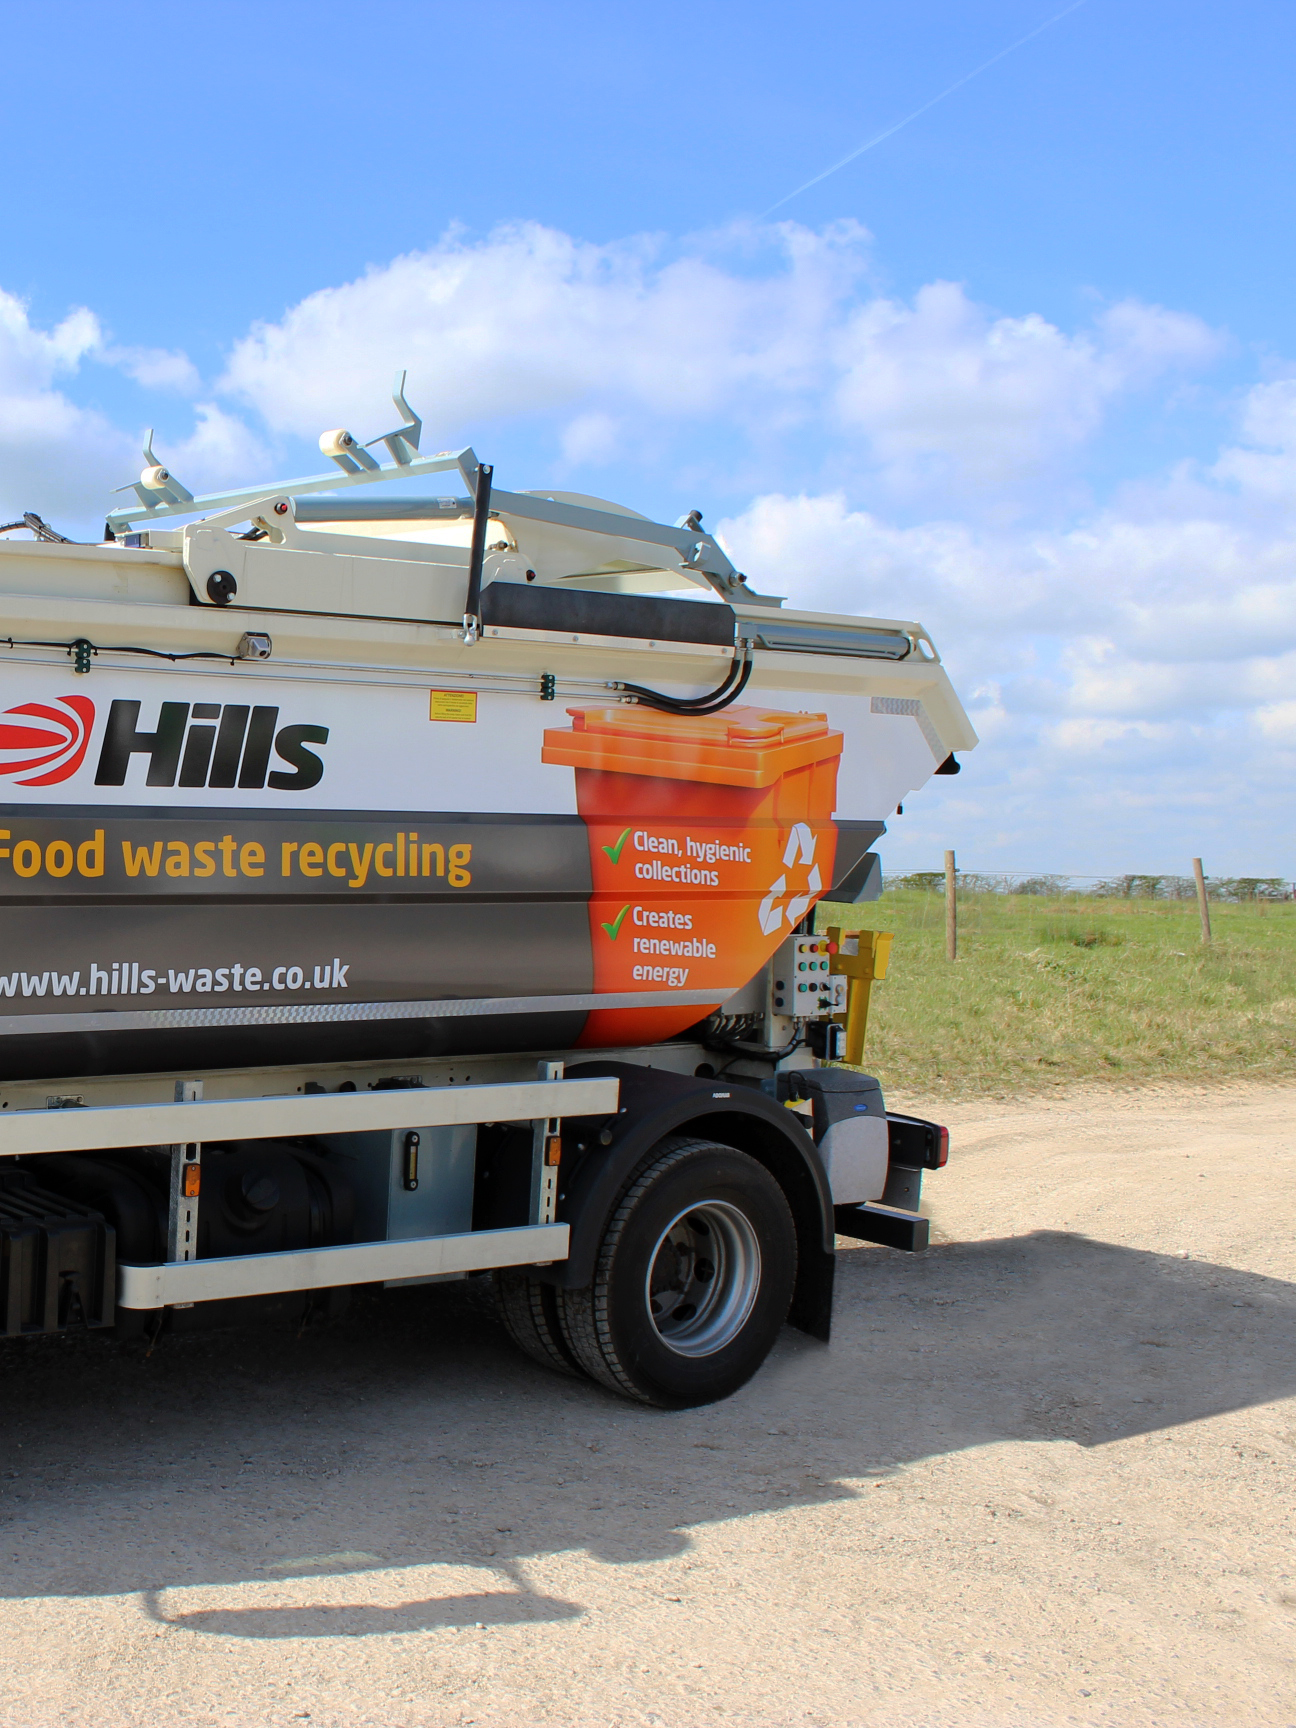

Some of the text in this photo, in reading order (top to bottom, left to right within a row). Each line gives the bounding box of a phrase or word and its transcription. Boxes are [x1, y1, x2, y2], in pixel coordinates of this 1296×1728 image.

[93, 699, 330, 791] Hills
[121, 834, 266, 878] waste
[281, 832, 473, 888] recycling
[633, 831, 752, 863] Clean, hygienic
[635, 860, 719, 886] collections
[633, 906, 693, 930] Creates
[633, 937, 717, 959] renewable
[632, 965, 689, 987] energy
